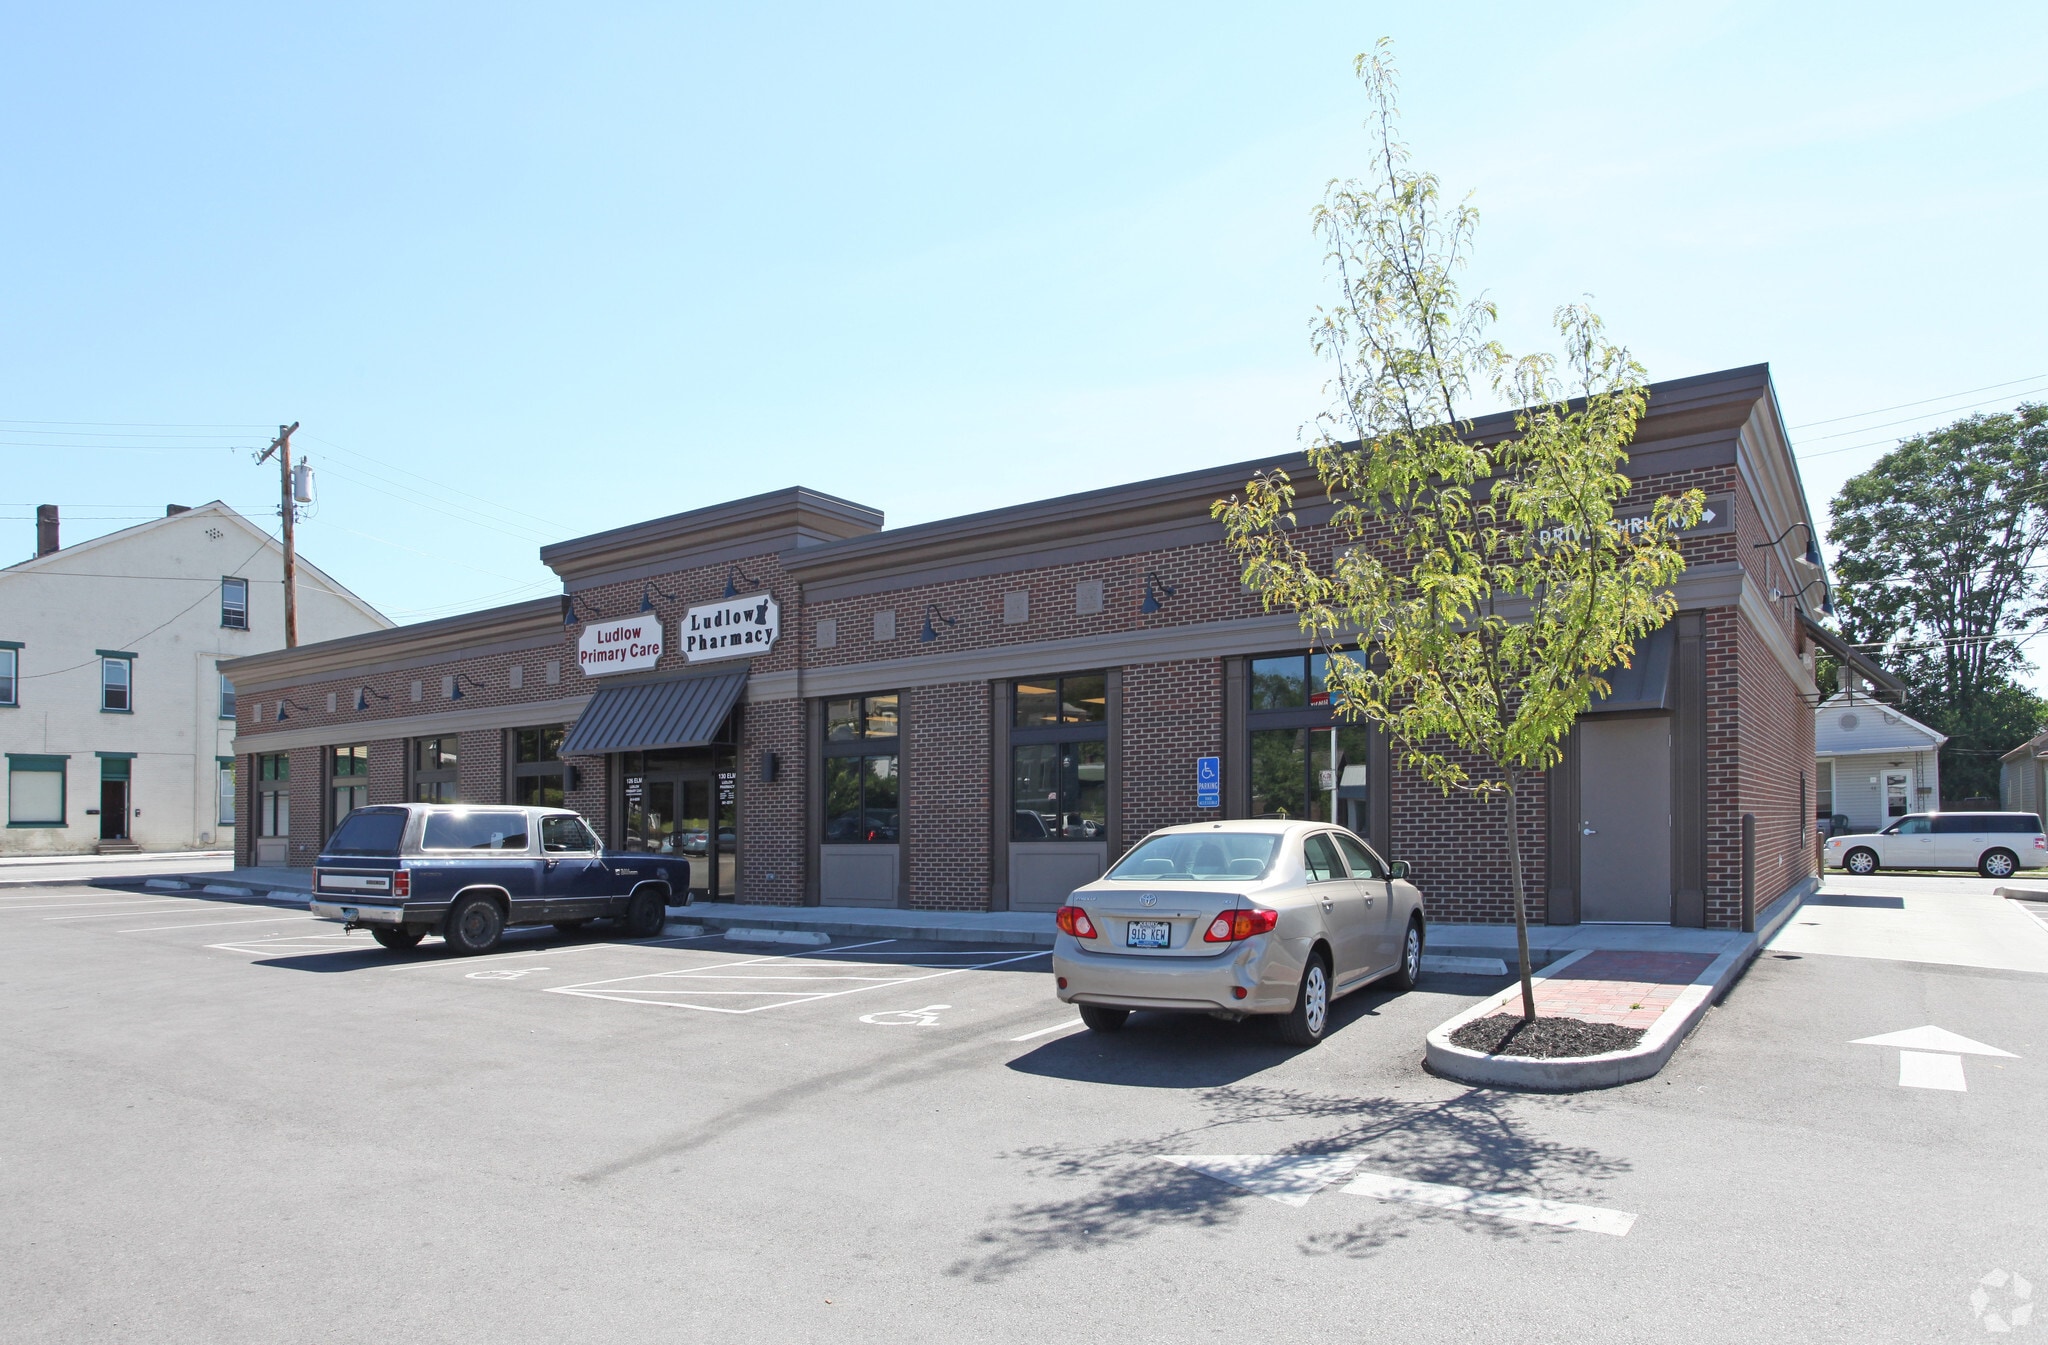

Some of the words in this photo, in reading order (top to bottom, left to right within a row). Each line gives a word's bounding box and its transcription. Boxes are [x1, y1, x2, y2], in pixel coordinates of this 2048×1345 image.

[1540, 522, 1592, 546] DRIV
[690, 609, 754, 632] Ludlow
[597, 627, 642, 645] Ludlow
[687, 627, 774, 653] Pharmacy
[580, 646, 627, 665] Primary
[629, 641, 660, 656] Care
[1199, 782, 1218, 790] PARKING
[1131, 928, 1147, 940] 916
[1150, 929, 1166, 941] KEW
